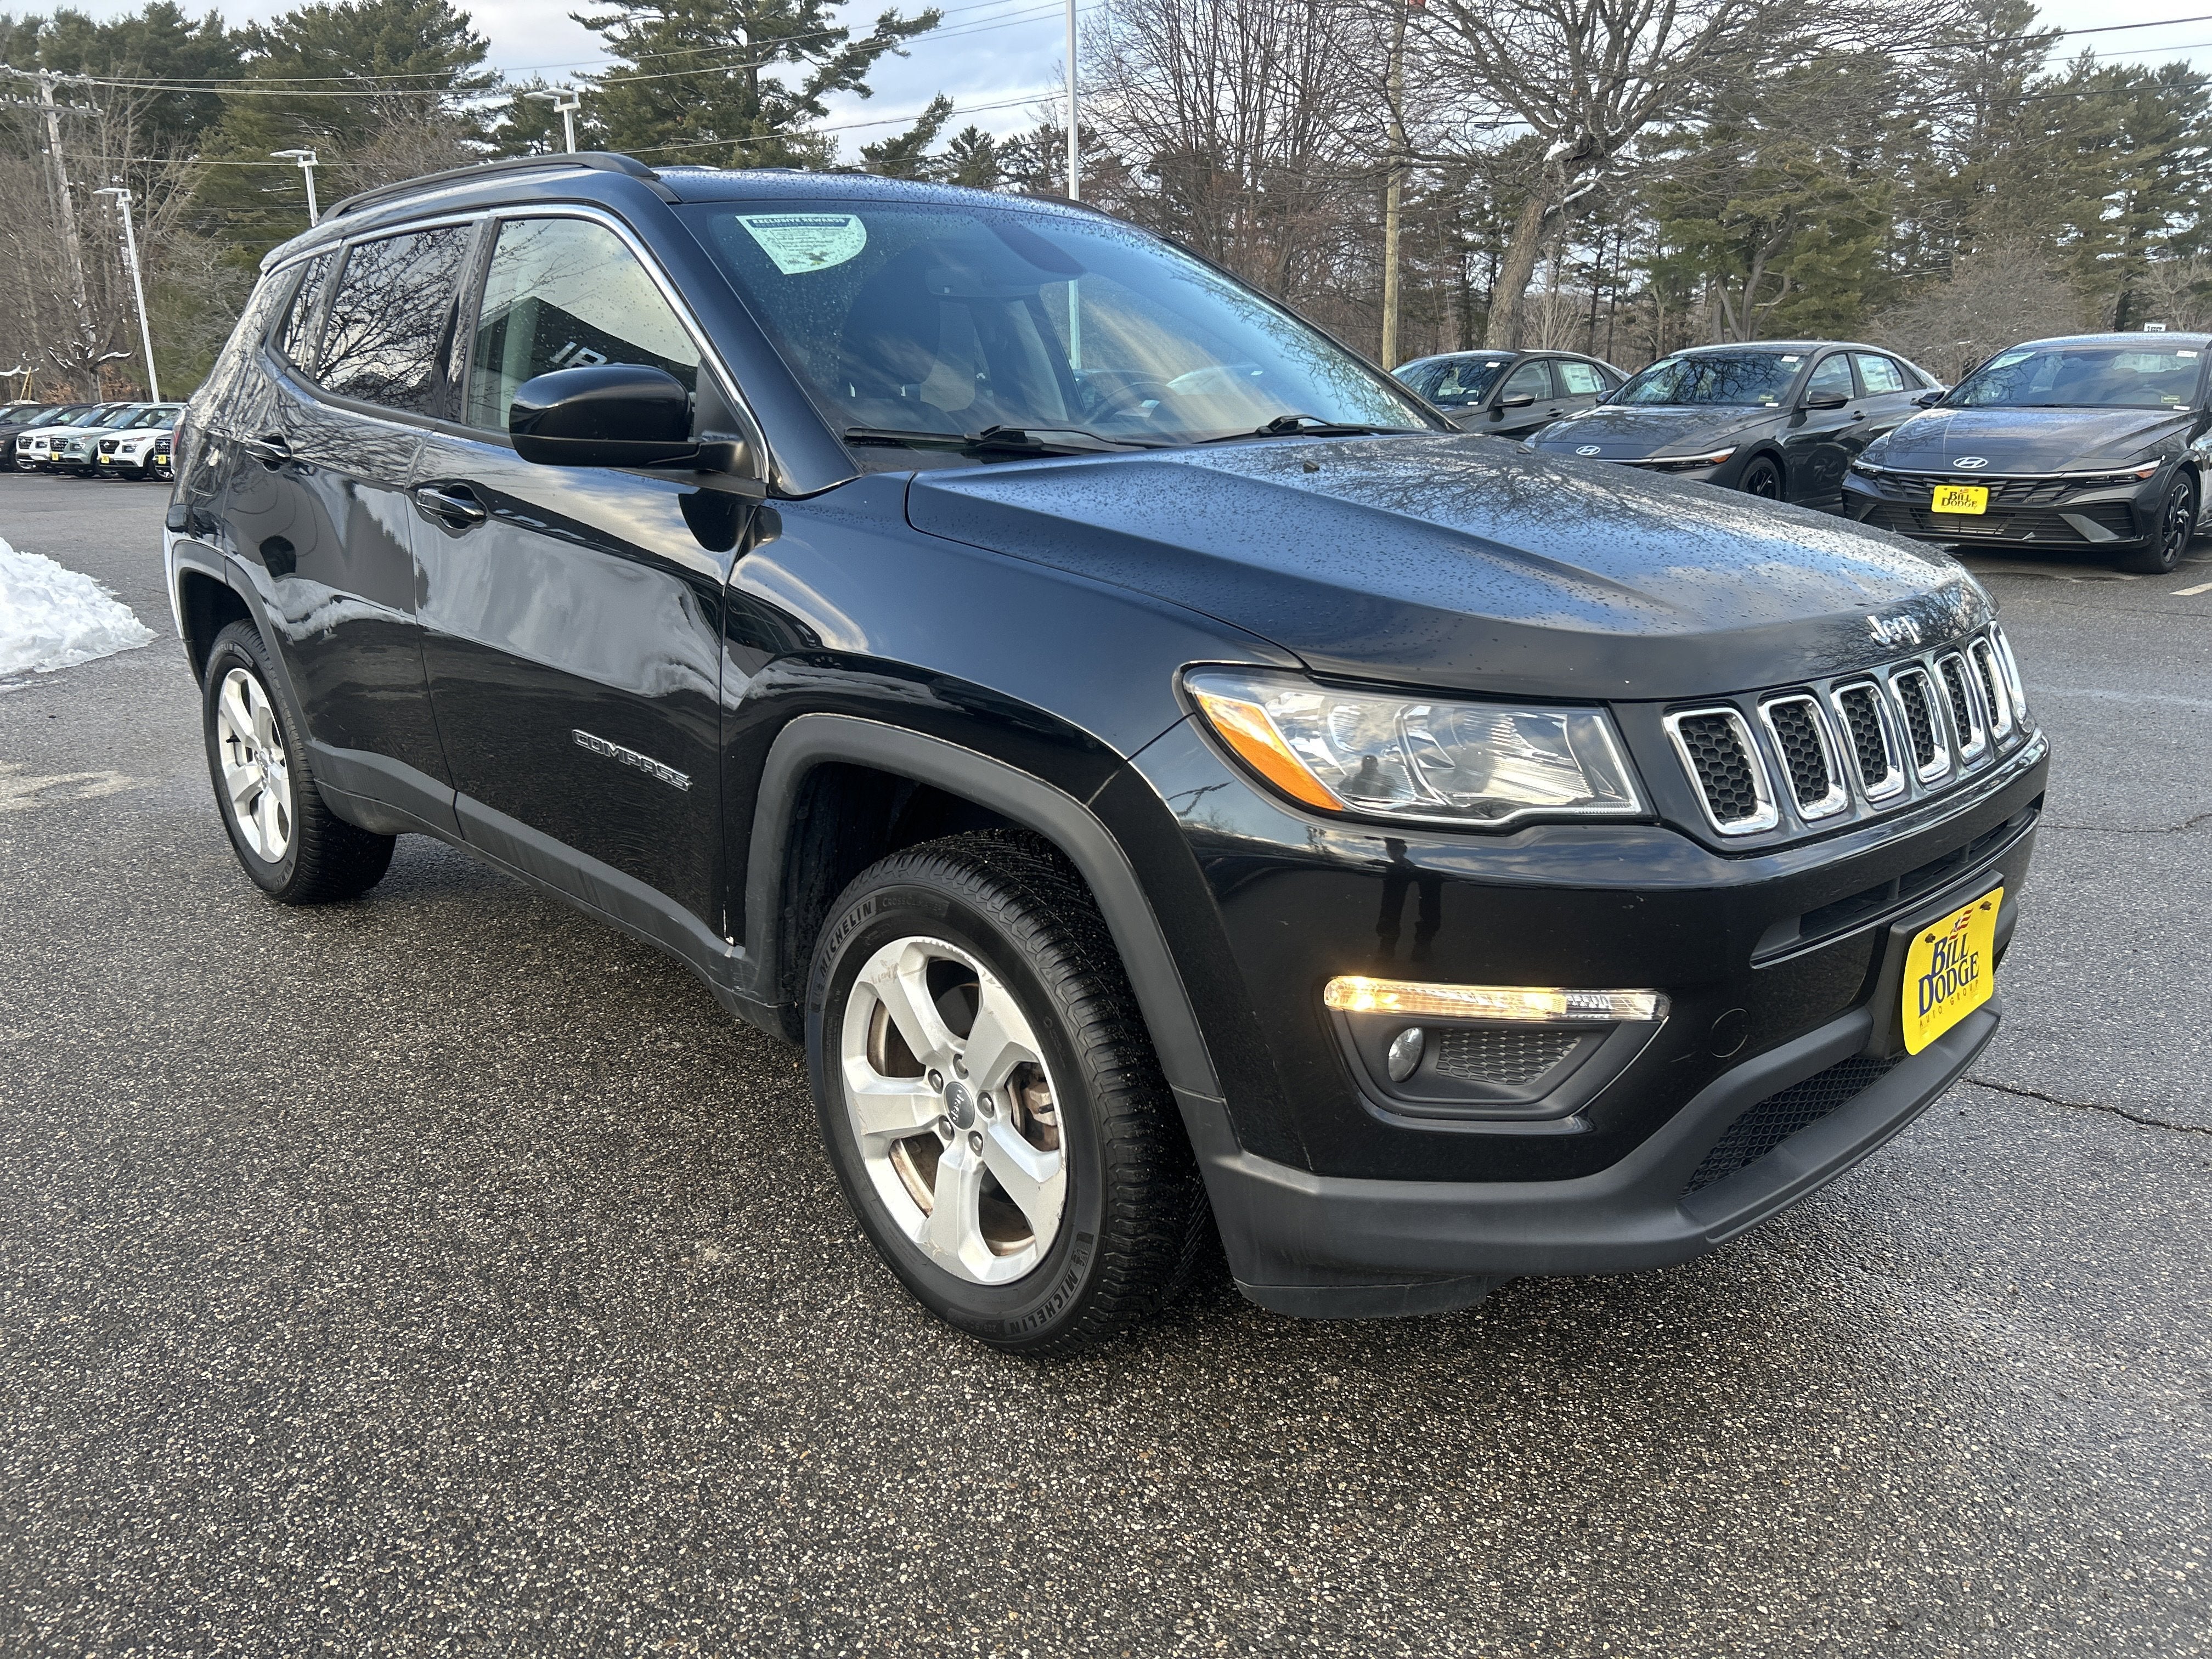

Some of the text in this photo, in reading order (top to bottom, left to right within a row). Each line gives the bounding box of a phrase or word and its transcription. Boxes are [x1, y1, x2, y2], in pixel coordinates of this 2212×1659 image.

[1942, 497, 1977, 507] DODGE
[1949, 491, 1972, 503] BILL
[1866, 614, 1922, 646] Jeep
[572, 729, 693, 792] COMPASS
[819, 900, 873, 978] MICHELIN
[1932, 933, 1970, 977] BILL
[1918, 951, 1979, 1019] DODGE
[1920, 979, 1979, 1028] AUTO GROUP
[1009, 1268, 1079, 1334] MICHELIN
